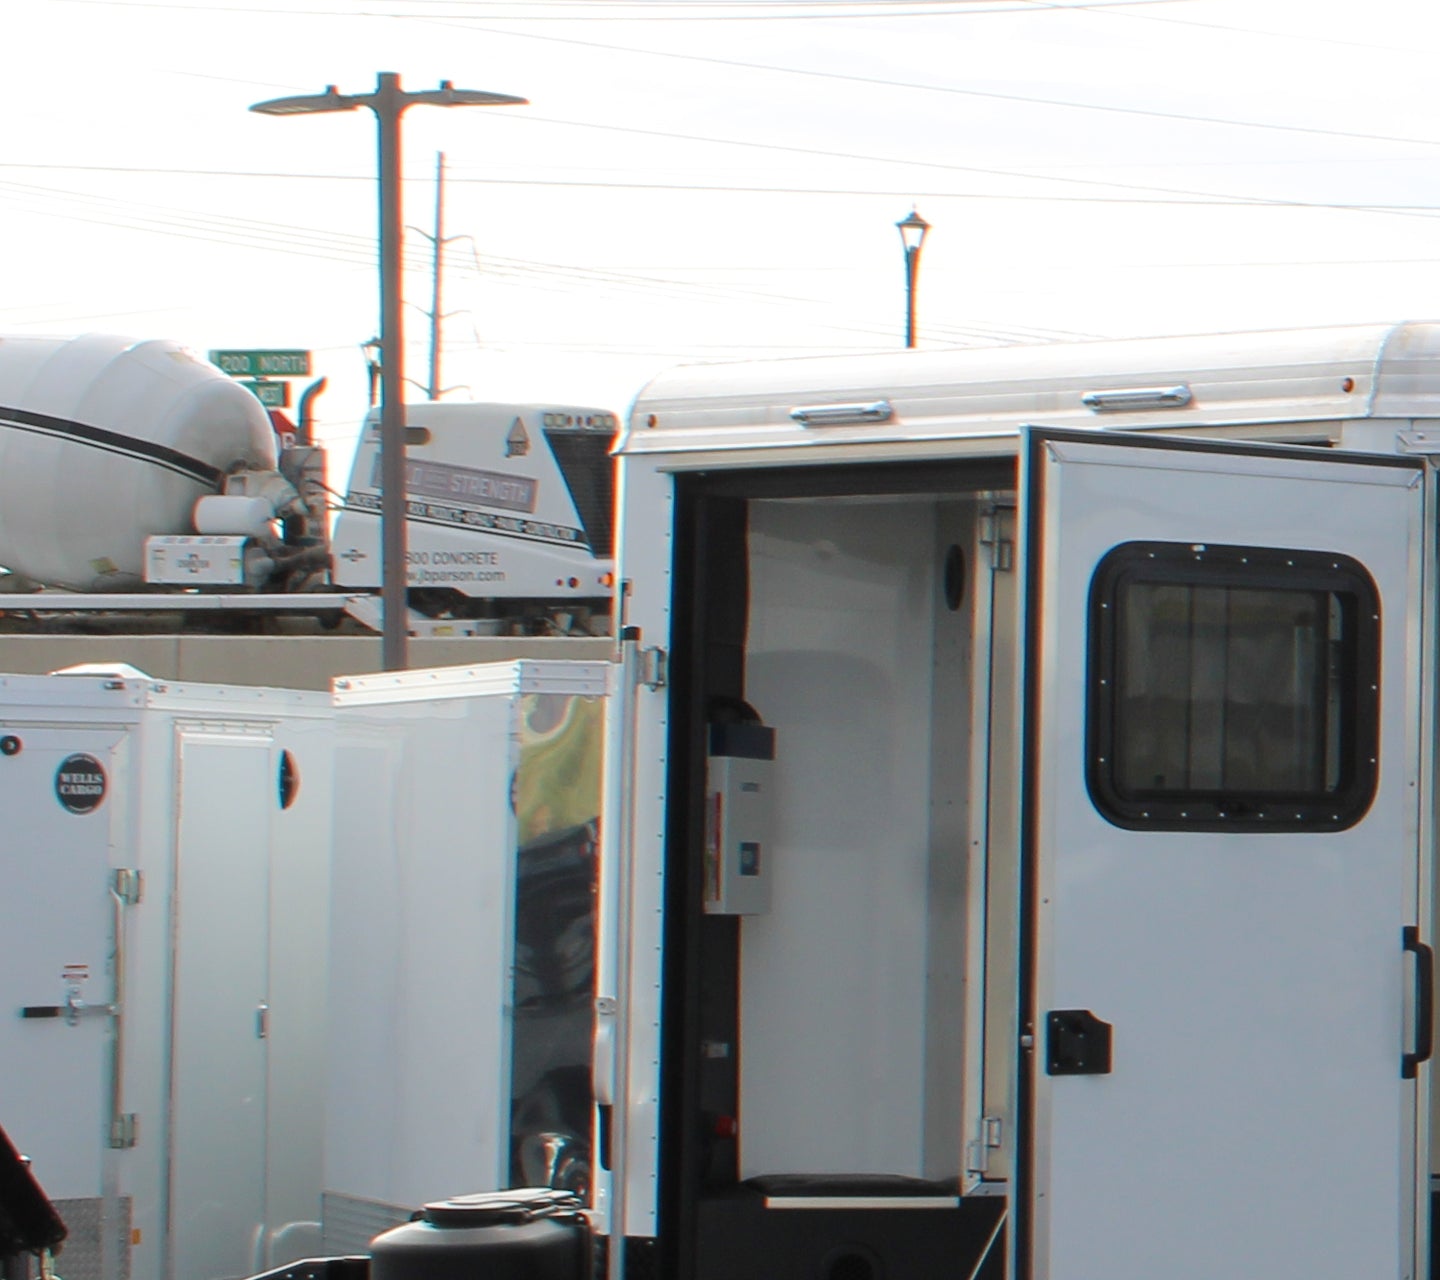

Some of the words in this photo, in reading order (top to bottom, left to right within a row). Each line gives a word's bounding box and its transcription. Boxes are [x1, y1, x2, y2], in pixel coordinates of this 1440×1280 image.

[222, 356, 250, 373] 200
[259, 355, 308, 373] NORTH
[450, 473, 532, 504] STRENGTH
[432, 552, 499, 566] CONCRETE
[60, 773, 103, 783] WELLS
[60, 784, 103, 794] CARGO
